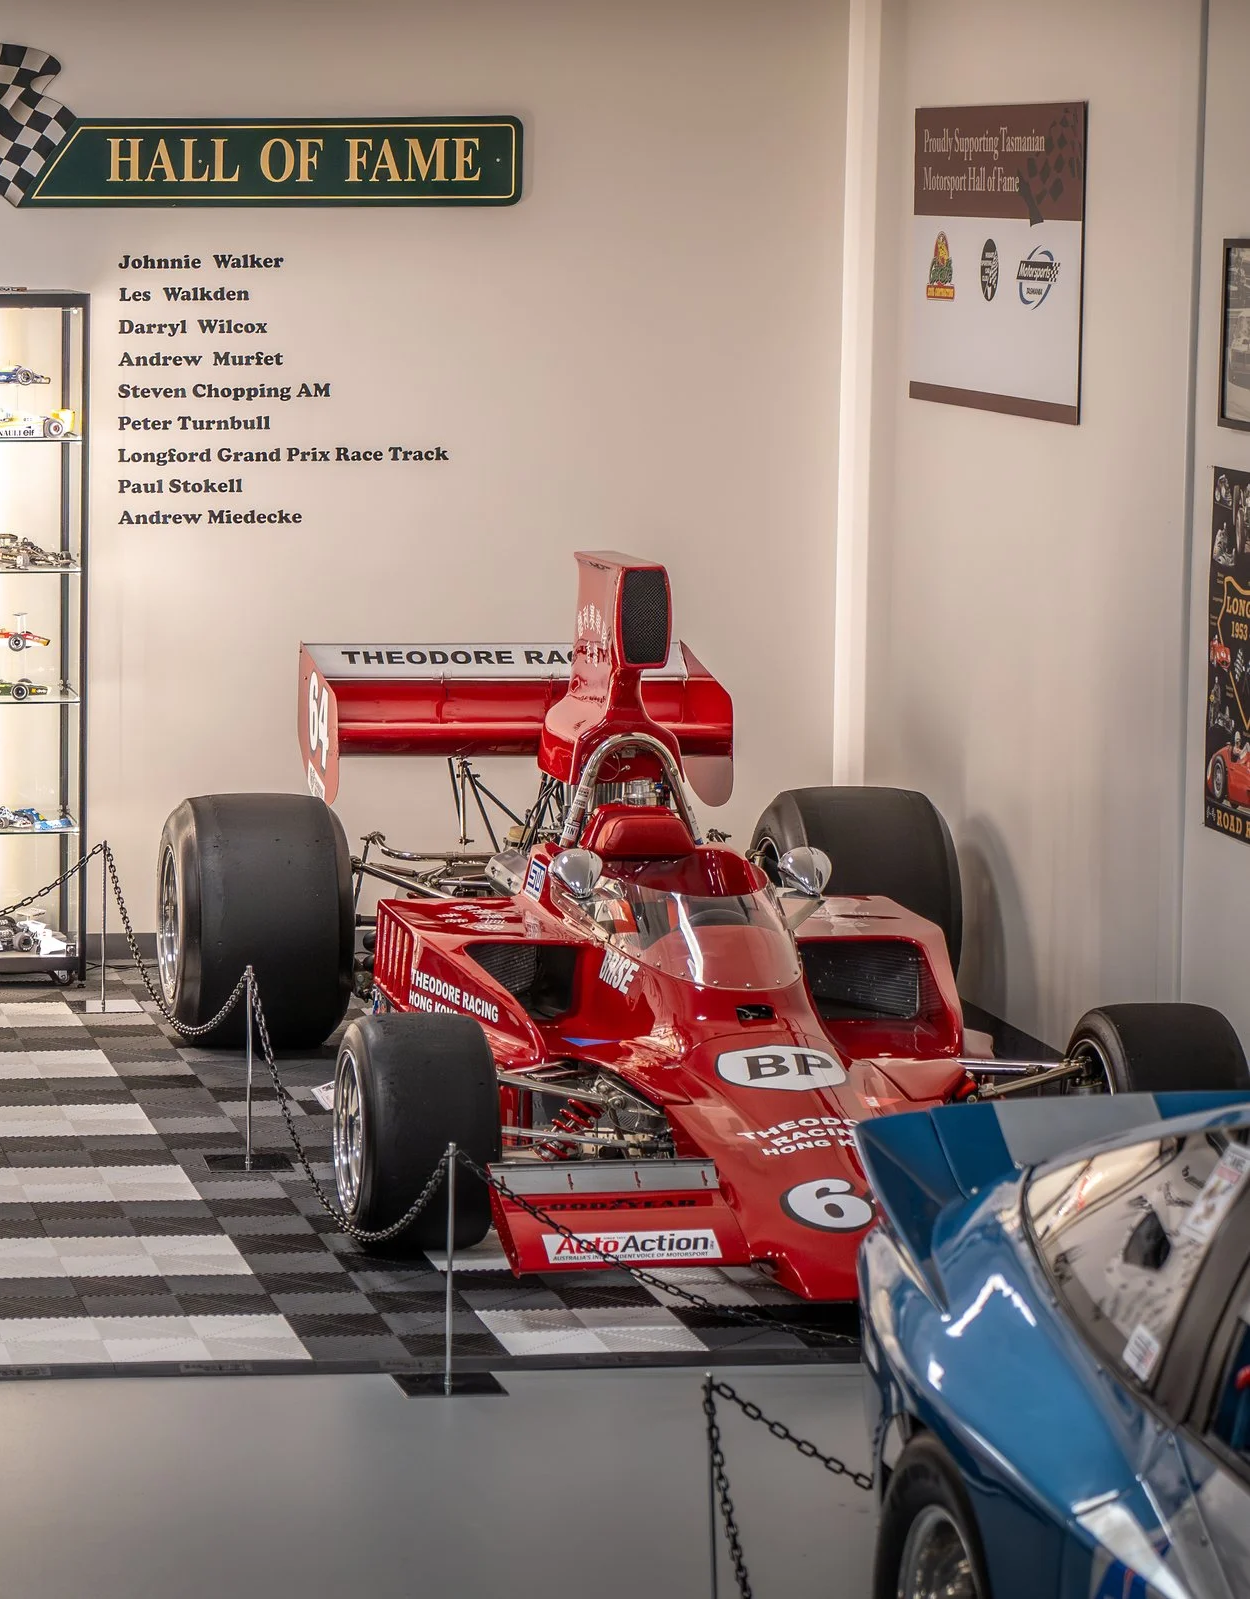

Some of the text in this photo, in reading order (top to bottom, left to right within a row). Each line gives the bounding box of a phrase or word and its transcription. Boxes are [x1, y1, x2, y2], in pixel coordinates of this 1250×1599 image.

[924, 126, 1045, 160] Proudly Supporting Tasmanian
[106, 138, 481, 183] HALL OF FAME
[923, 166, 1020, 199] Motorsport Hall of Fame
[118, 254, 284, 269] Johnnie Walker
[1019, 262, 1052, 281] Motorsports
[120, 287, 249, 301] Les Walkden
[119, 319, 267, 337] Darryl Wilcox
[118, 352, 283, 366] Andrew Murfet
[118, 383, 330, 401] Steven Chopping AM
[118, 416, 270, 430] Peter Turnbull
[22, 429, 35, 437] elf
[118, 447, 449, 466] Longford Grand Prix Race Track
[118, 479, 242, 493] Paul Stokell
[118, 510, 302, 524] Andrew Miedecke
[1231, 621, 1248, 641] 1953
[341, 650, 515, 666] THEODORE
[308, 671, 329, 770] 64
[1217, 809, 1243, 835] ROAD
[409, 990, 458, 1015] HONG KO
[411, 968, 499, 1023] THEODORE RACING
[745, 1053, 836, 1081] BP
[737, 1117, 859, 1140] THEODO
[771, 1128, 854, 1147] RACIN
[762, 1140, 831, 1156] HONG
[786, 1178, 876, 1229] 6
[666, 1250, 708, 1258] MOTORSPORT
